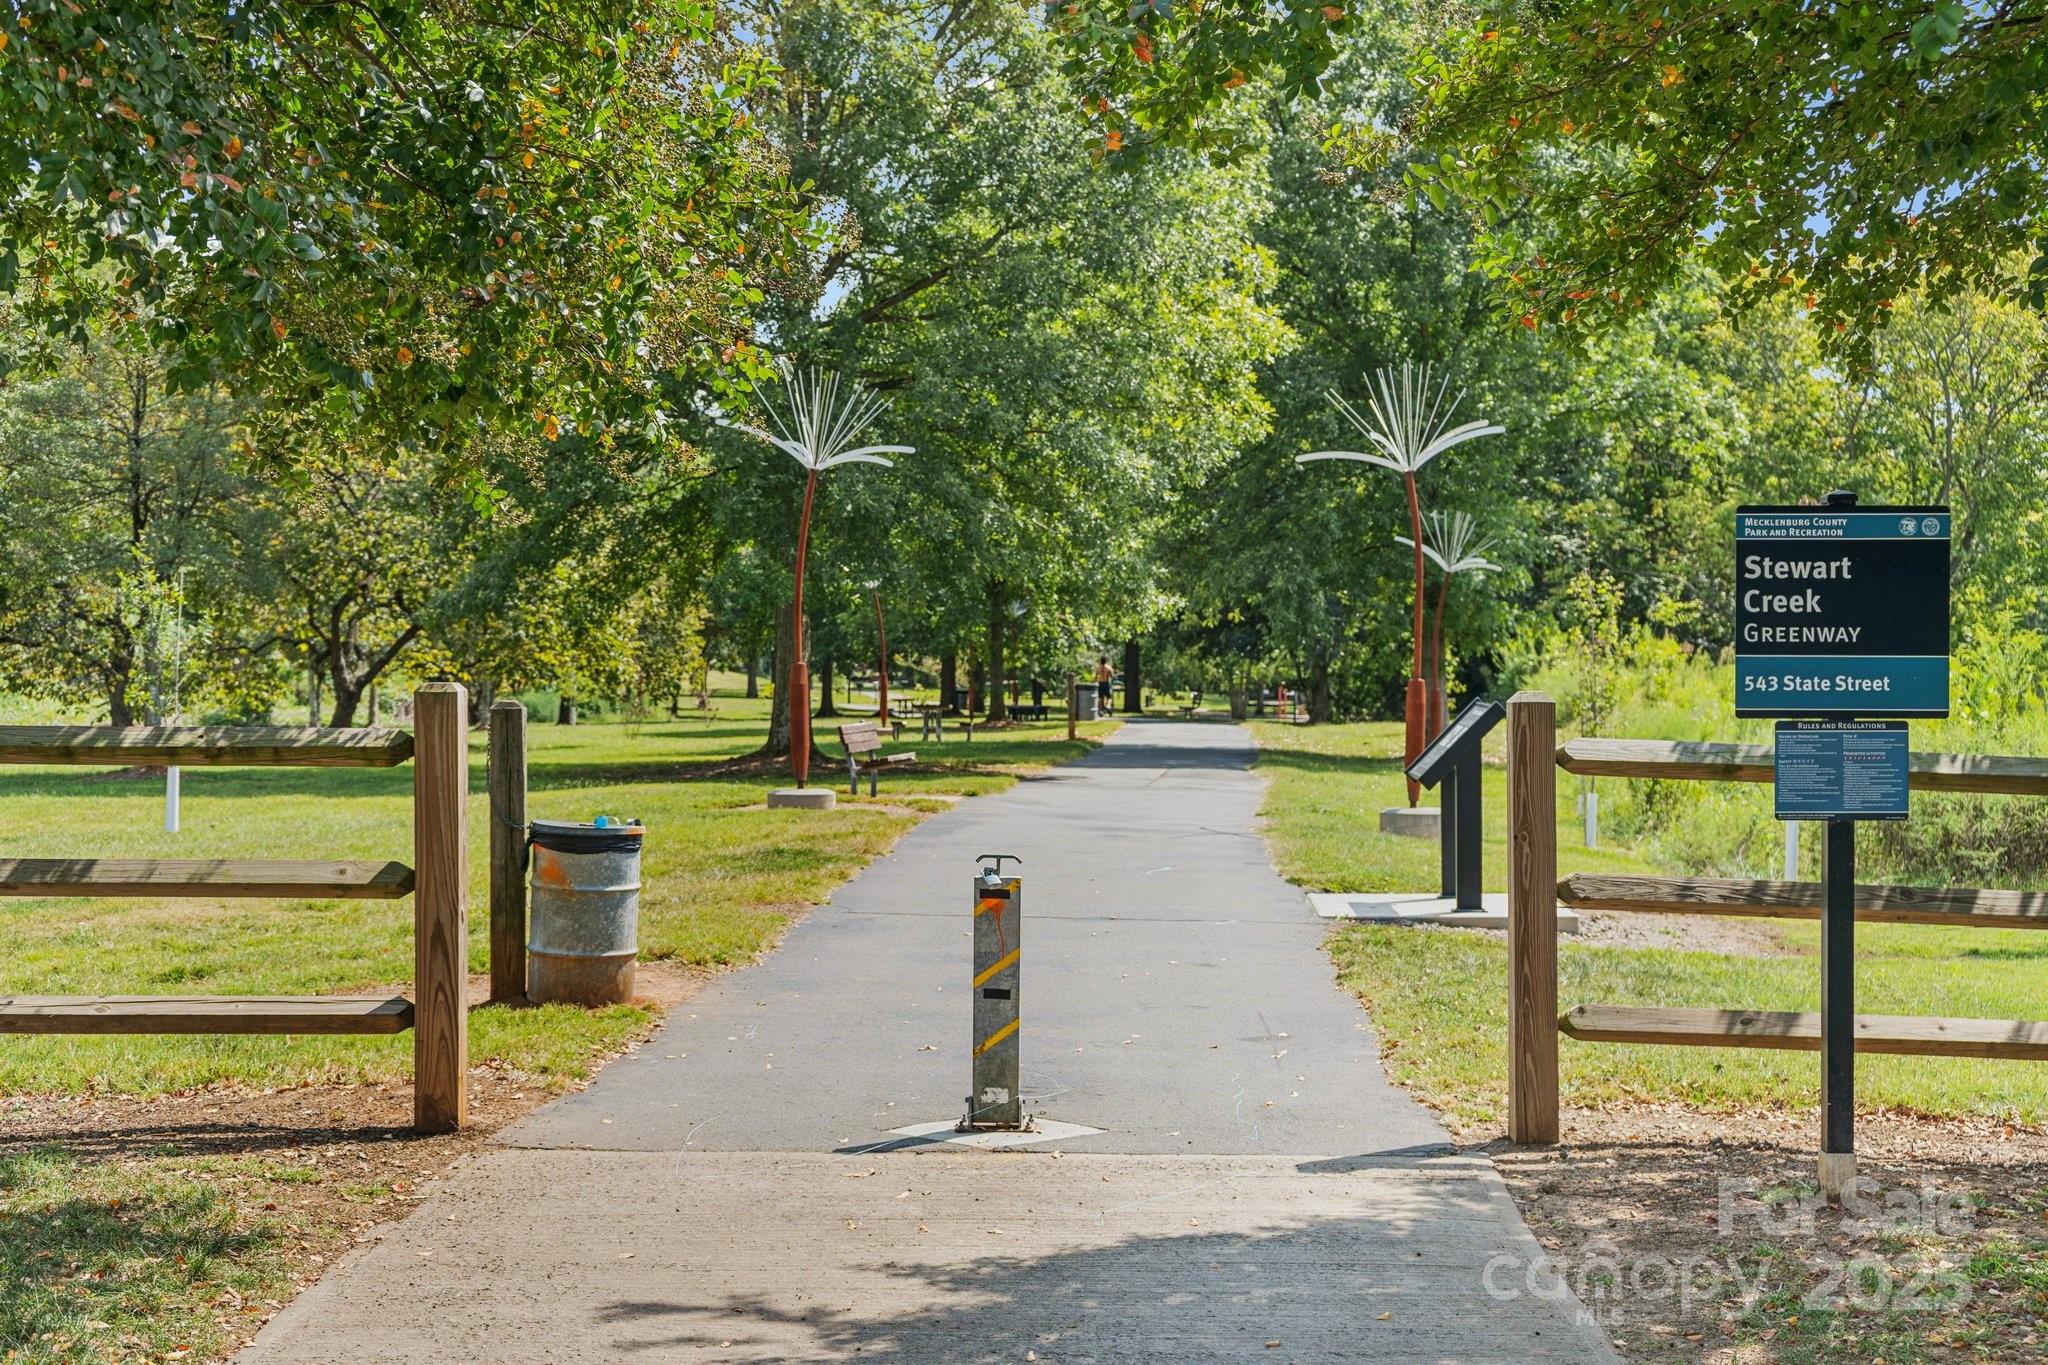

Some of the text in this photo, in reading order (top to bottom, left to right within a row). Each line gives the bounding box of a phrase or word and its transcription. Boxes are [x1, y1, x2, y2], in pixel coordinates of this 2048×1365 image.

[1745, 517, 1847, 526] MECKLENBURG COUNTY
[1745, 528, 1767, 536] PARK
[1789, 528, 1843, 536] RECREATION
[1744, 555, 1852, 579] Stewart
[1743, 588, 1822, 613] Creek
[1743, 623, 1861, 643] GREENWAY
[1744, 675, 1890, 692] 543 State Street
[1797, 722, 1820, 730] RULES
[1838, 722, 1887, 730] REGULATIONS
